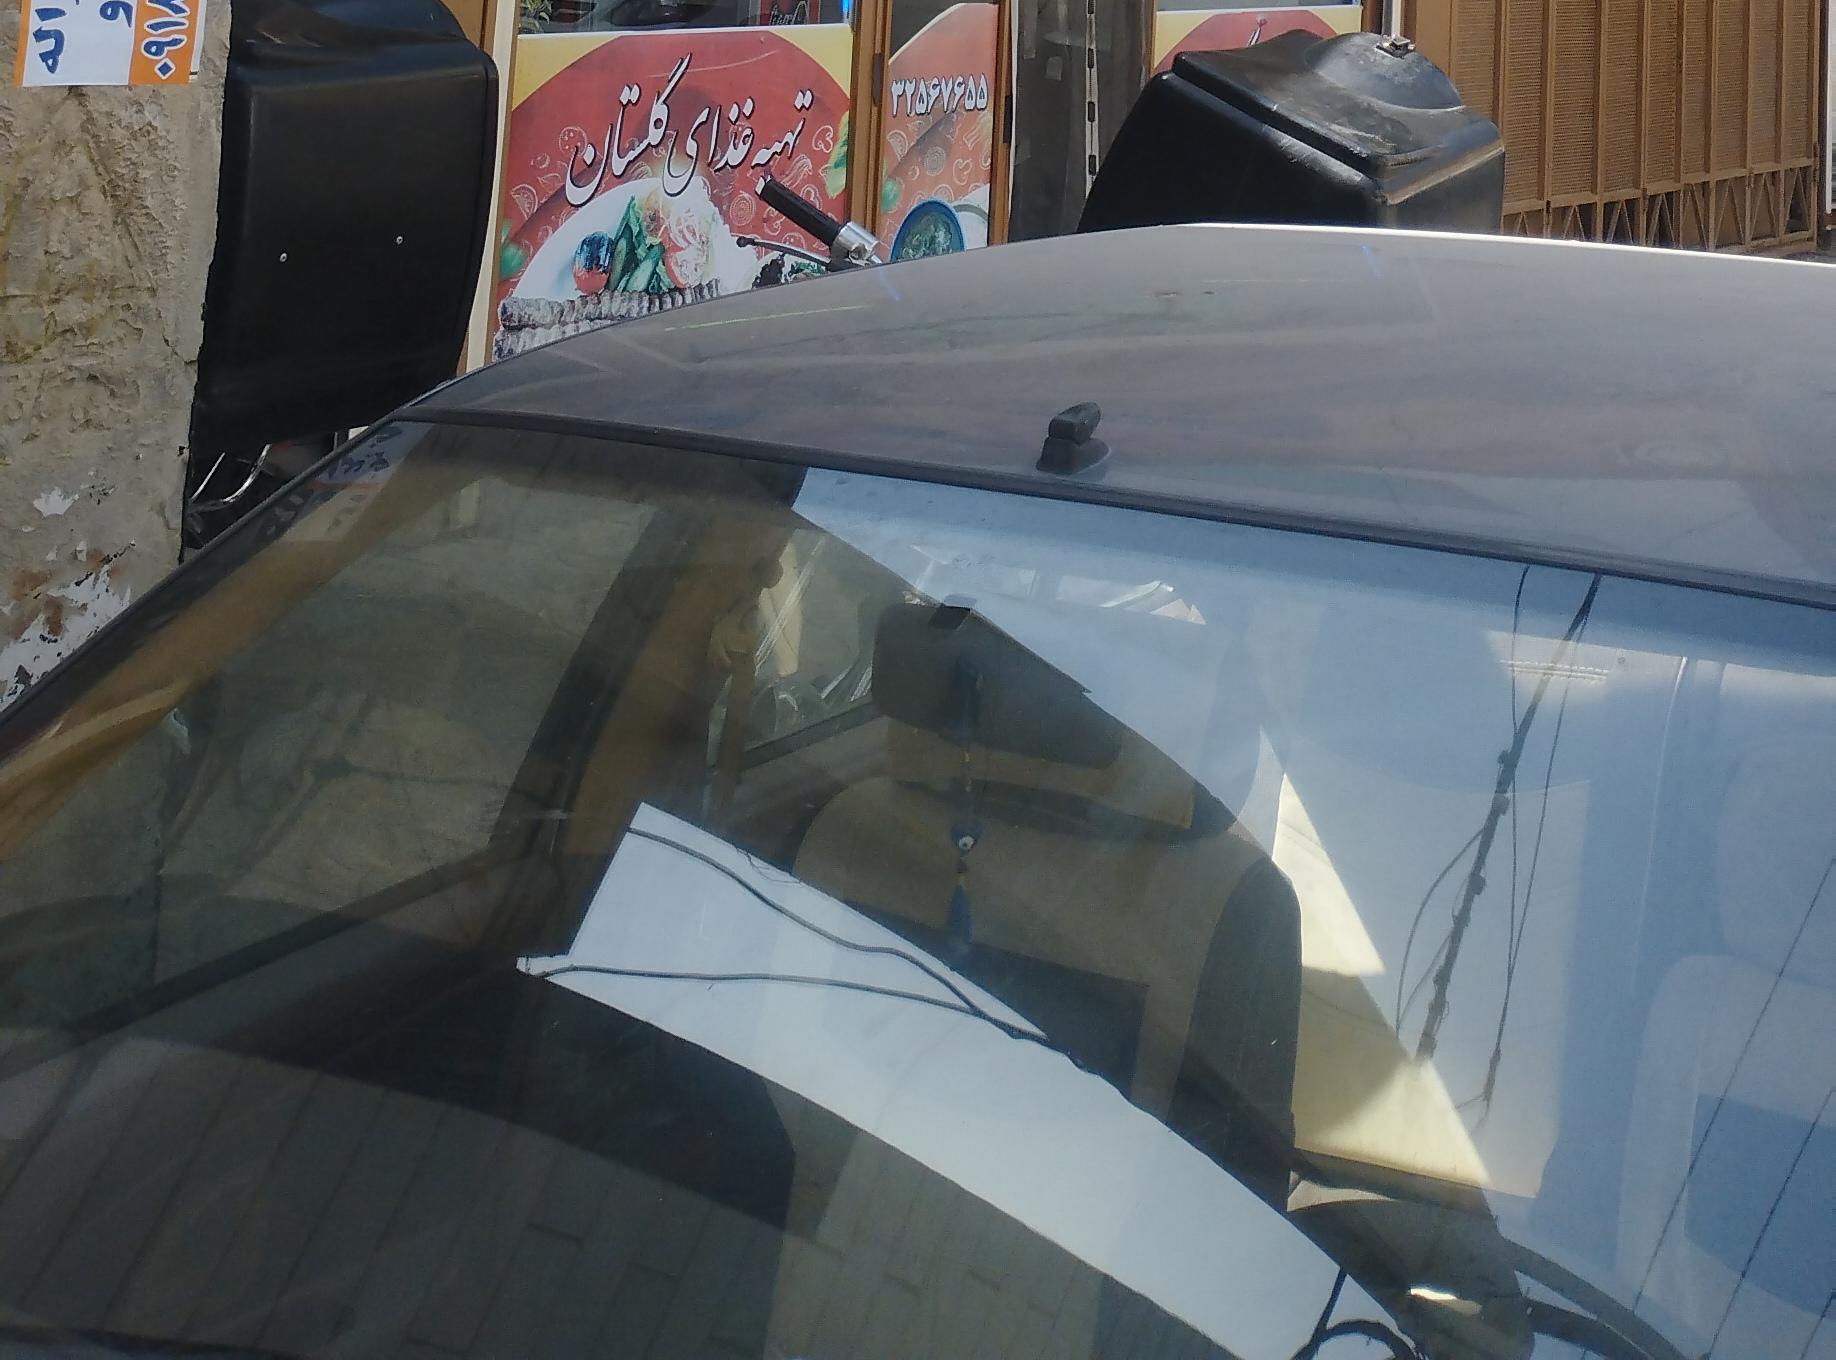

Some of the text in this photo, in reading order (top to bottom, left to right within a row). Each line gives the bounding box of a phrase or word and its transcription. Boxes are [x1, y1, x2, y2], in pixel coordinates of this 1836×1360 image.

[565, 51, 814, 208] تهیه غذای گلستان
[890, 72, 989, 118] ۳۲۵۶۷۶۵۵
